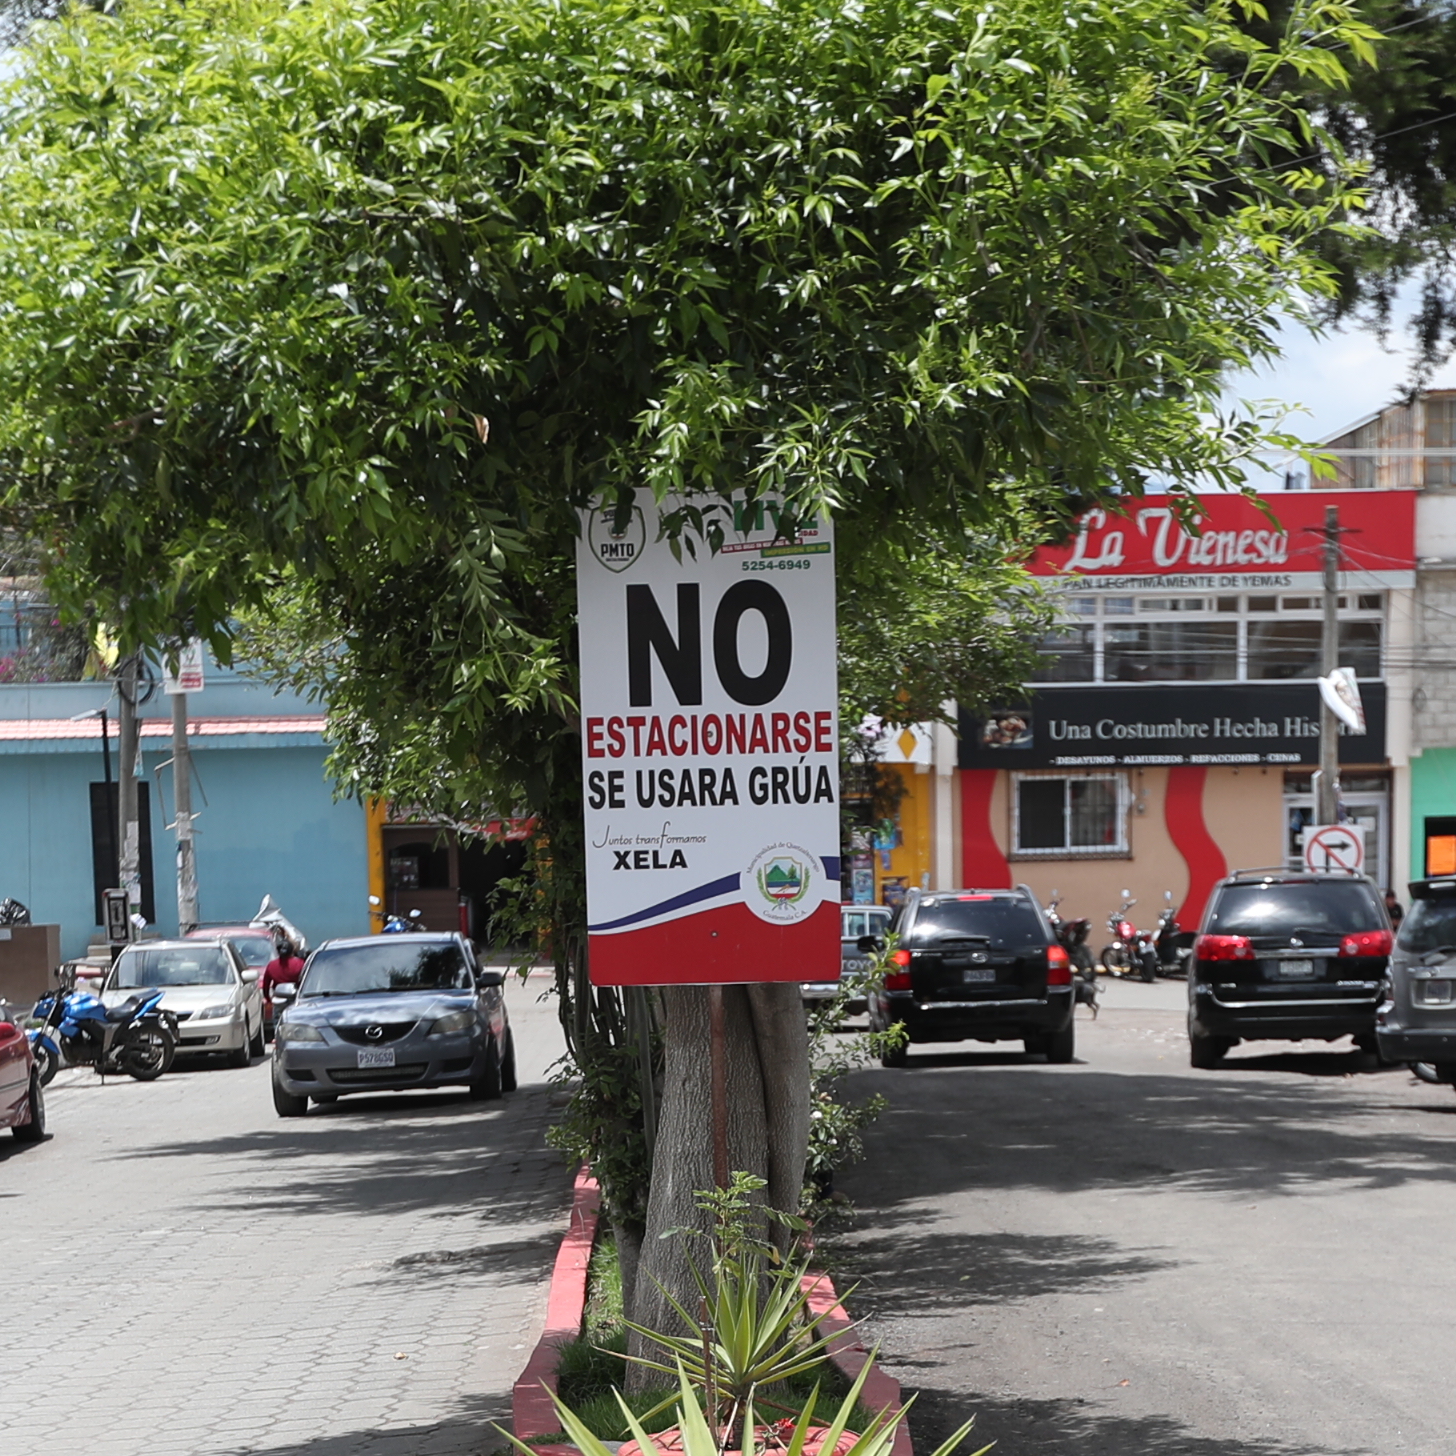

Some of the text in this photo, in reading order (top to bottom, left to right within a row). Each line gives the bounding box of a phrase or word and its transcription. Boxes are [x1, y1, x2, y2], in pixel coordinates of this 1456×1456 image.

[600, 542, 635, 557] PMTO
[1062, 507, 1289, 571] La Vienesa
[741, 559, 811, 571] 5254-6949
[1219, 575, 1240, 588] DE
[1243, 575, 1293, 588] YEMAS
[626, 579, 792, 707] NO
[587, 711, 833, 759] ESTACIONARSE
[1049, 719, 1092, 740] Una
[1095, 718, 1210, 740] Costumbre
[1213, 717, 1280, 738] Hecha
[588, 756, 834, 809] SE USARA GRÚA
[592, 825, 633, 848] Juntos
[612, 849, 688, 870] XELA
